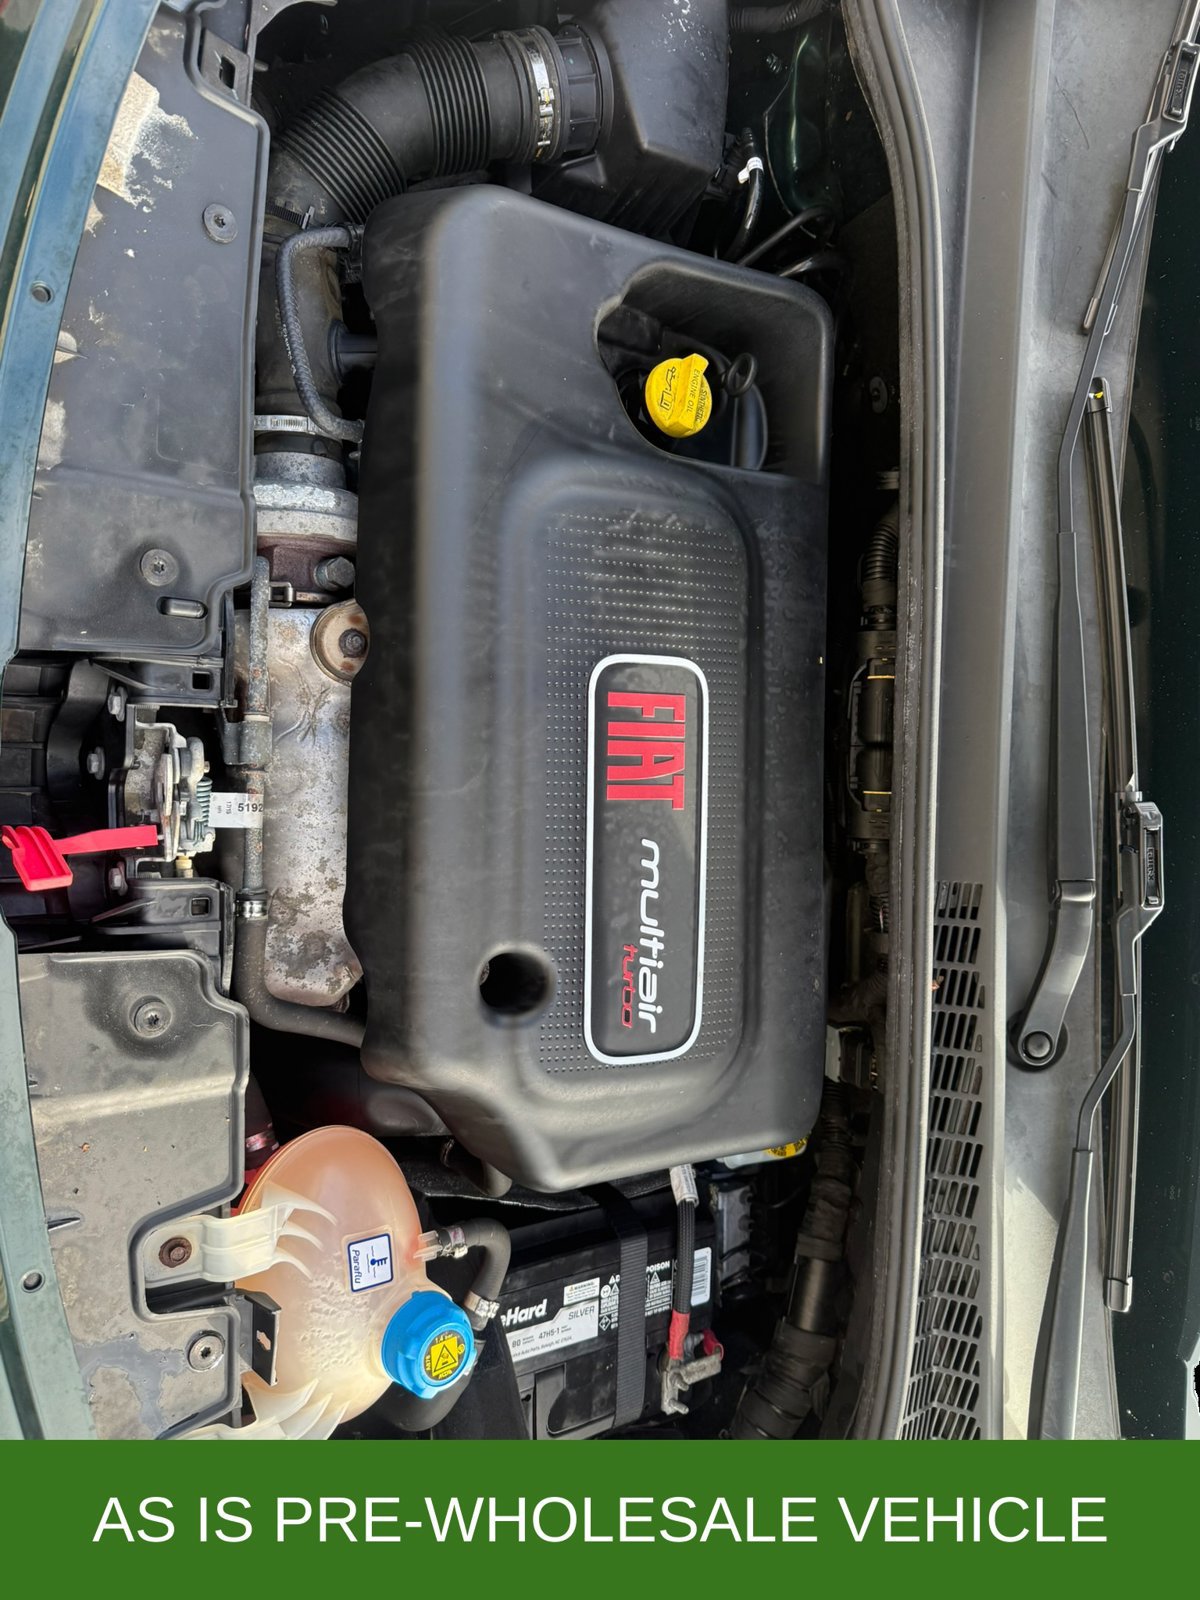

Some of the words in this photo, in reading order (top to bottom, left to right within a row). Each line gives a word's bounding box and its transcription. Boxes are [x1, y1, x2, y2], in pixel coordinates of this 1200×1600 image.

[691, 368, 700, 399] ENGINE
[686, 400, 694, 413] OIL
[696, 389, 708, 423] SYNTHETIC
[606, 691, 686, 811] FIAT
[237, 802, 264, 813] 5192
[638, 838, 665, 1034] multiair
[621, 944, 638, 1029] turbo
[351, 1249, 363, 1284] Paraflu
[646, 1260, 671, 1273] POISON
[568, 1305, 595, 1321] SILVER
